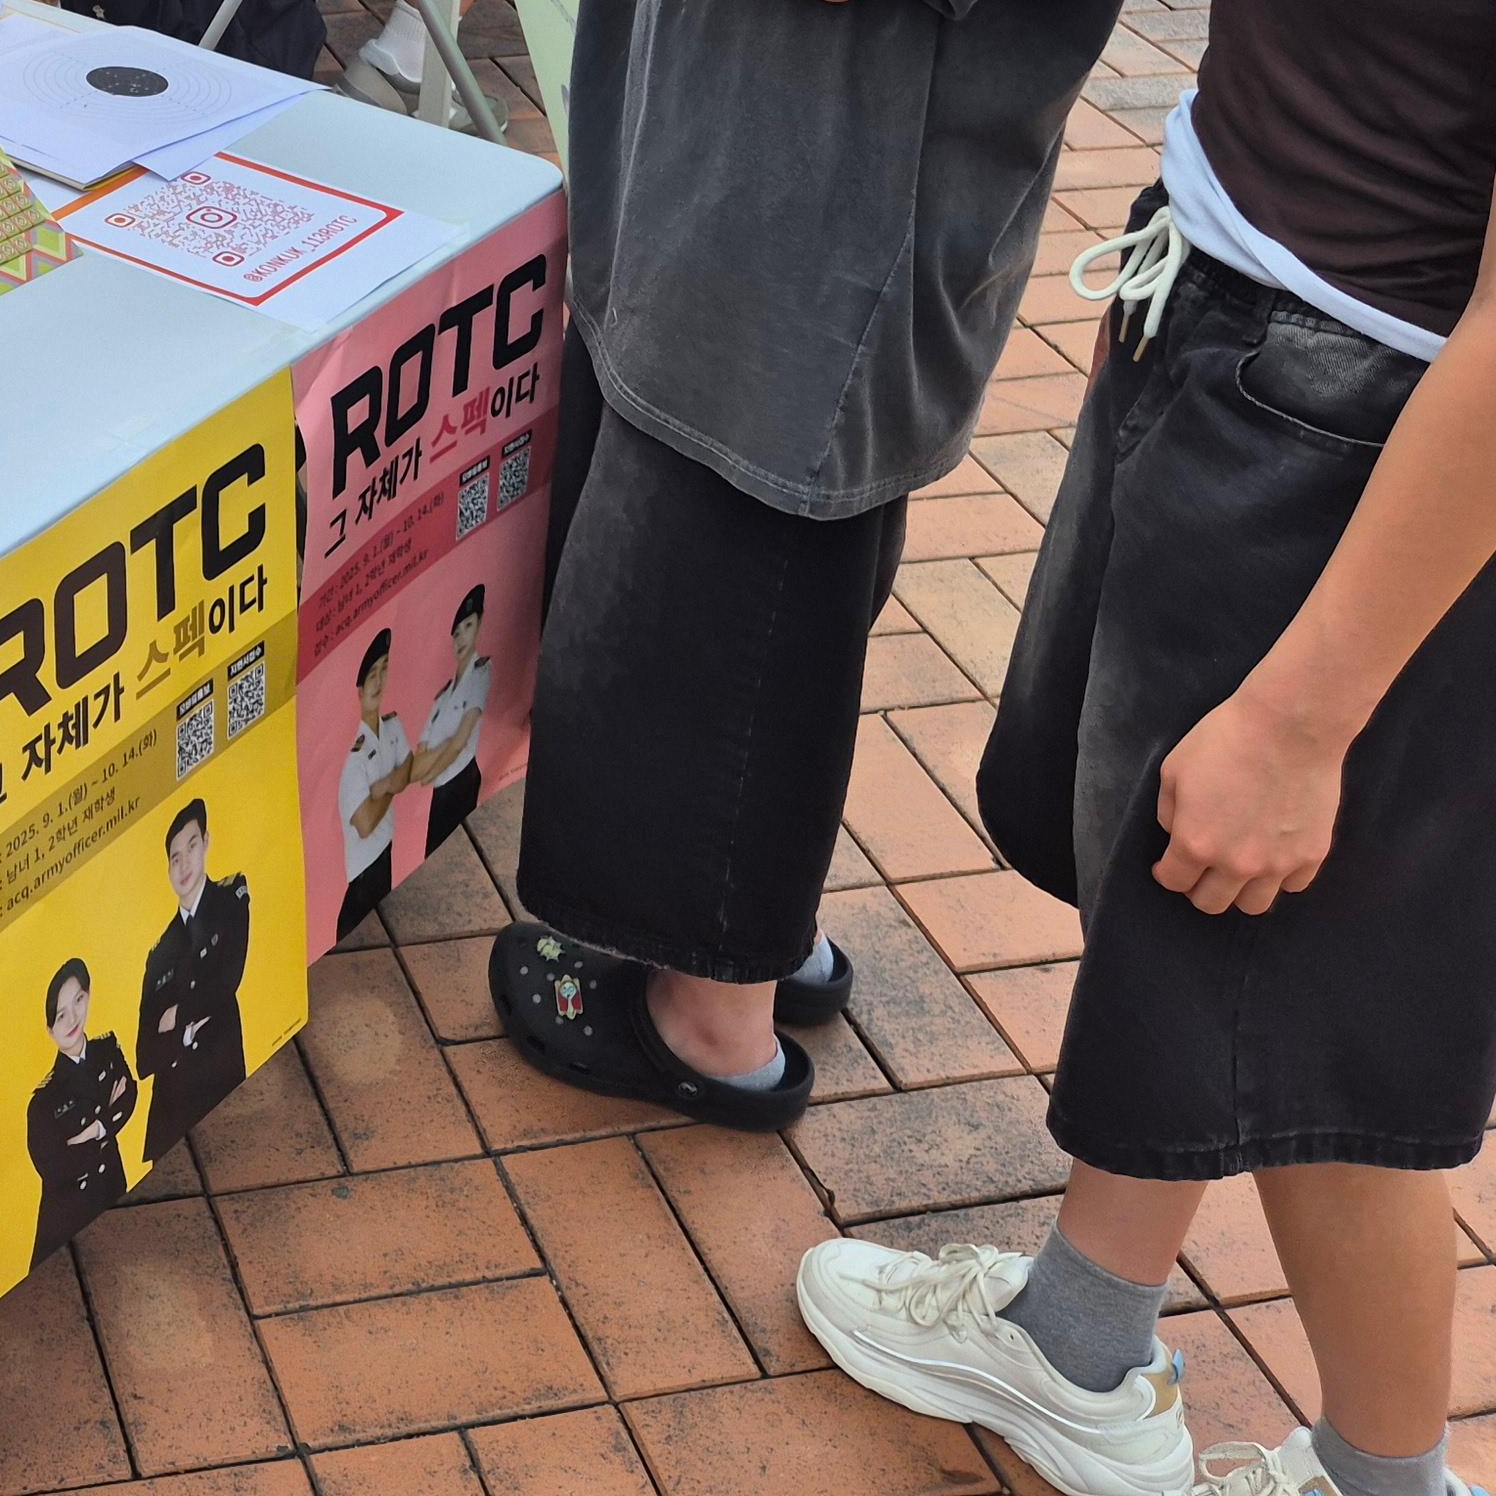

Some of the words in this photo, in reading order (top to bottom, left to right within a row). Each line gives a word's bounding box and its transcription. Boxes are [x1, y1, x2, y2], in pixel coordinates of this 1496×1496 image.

[330, 253, 546, 501] ROTC
[324, 508, 347, 559] 그
[354, 436, 423, 527] 자체가
[429, 361, 540, 465] 스펙이다
[21, 672, 125, 782] 자체가
[136, 565, 267, 700] 스펙이다
[6, 824, 39, 858] 2025.
[42, 812, 53, 829] 9.
[57, 782, 88, 817] 1.(월)
[102, 762, 118, 784] 10.
[6, 856, 30, 884] 남녀
[48, 820, 79, 852] 2학년
[82, 787, 116, 823] 재학생
[6, 796, 141, 912] acq.armyofficer.mil.kr
